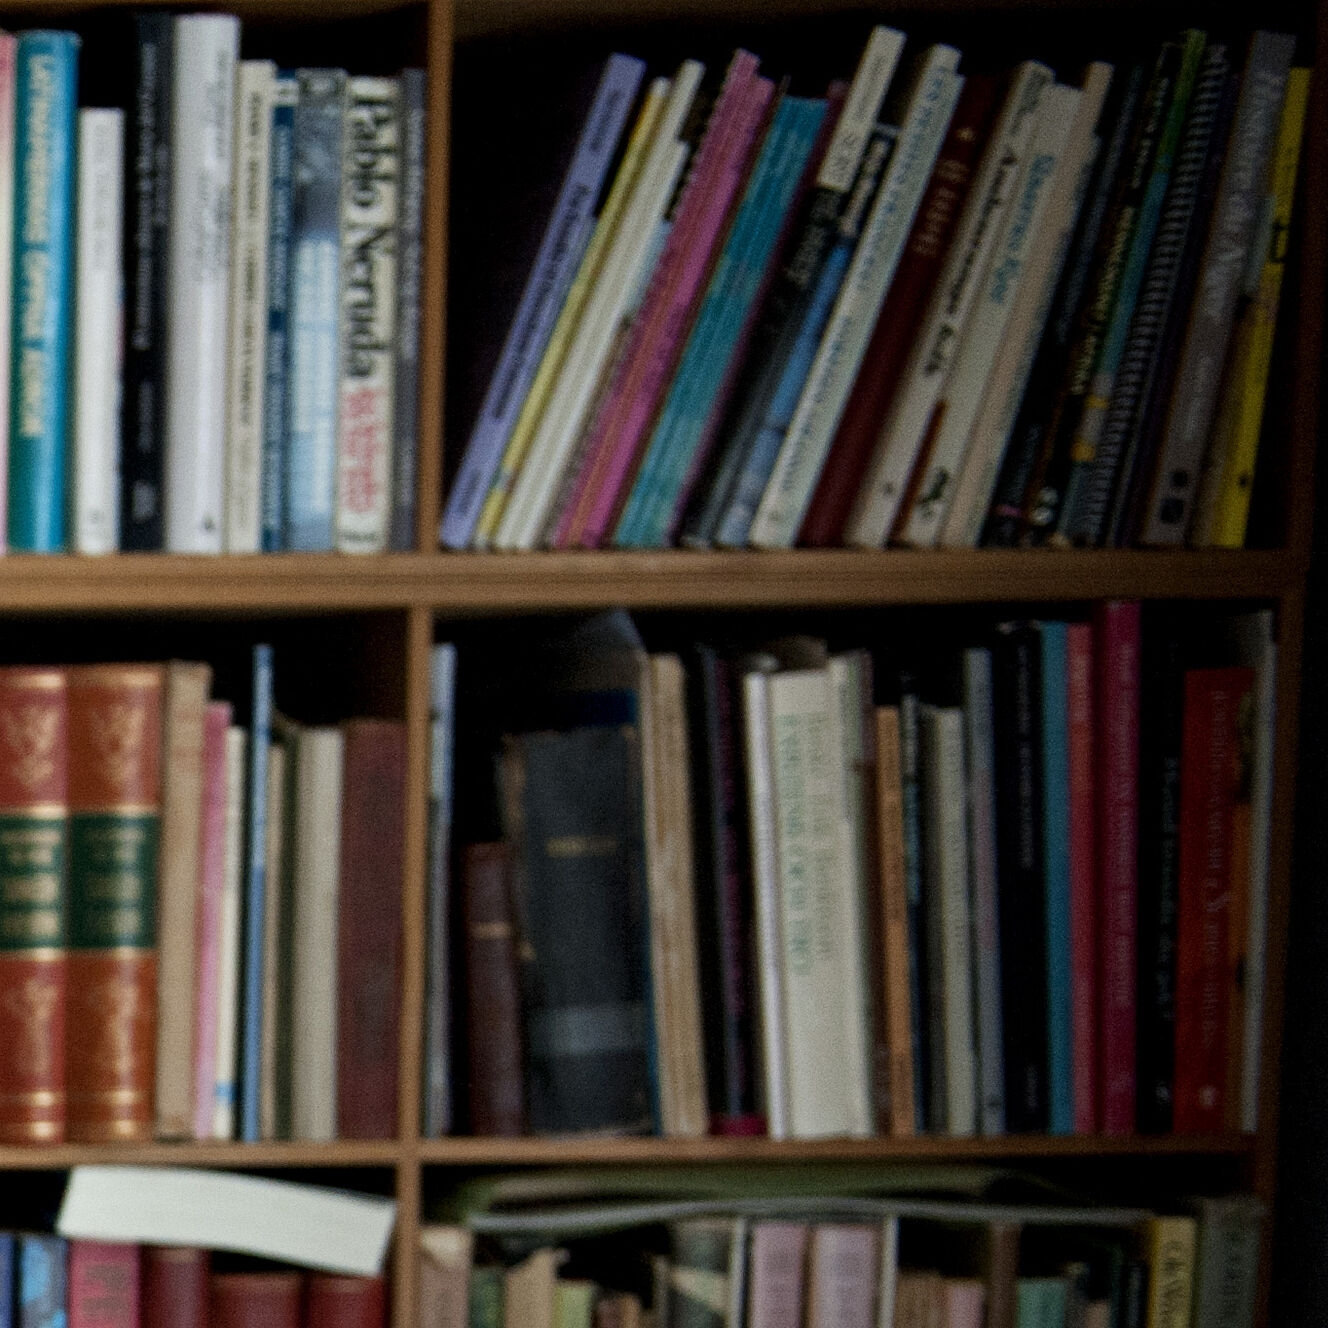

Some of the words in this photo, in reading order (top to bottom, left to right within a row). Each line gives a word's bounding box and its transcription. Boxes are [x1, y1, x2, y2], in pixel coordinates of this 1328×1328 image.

[347, 93, 398, 208] Pablo
[1227, 66, 1286, 193] Histoire
[1219, 192, 1255, 236] du
[344, 222, 397, 380] Neruda
[1197, 238, 1245, 325] Niger
